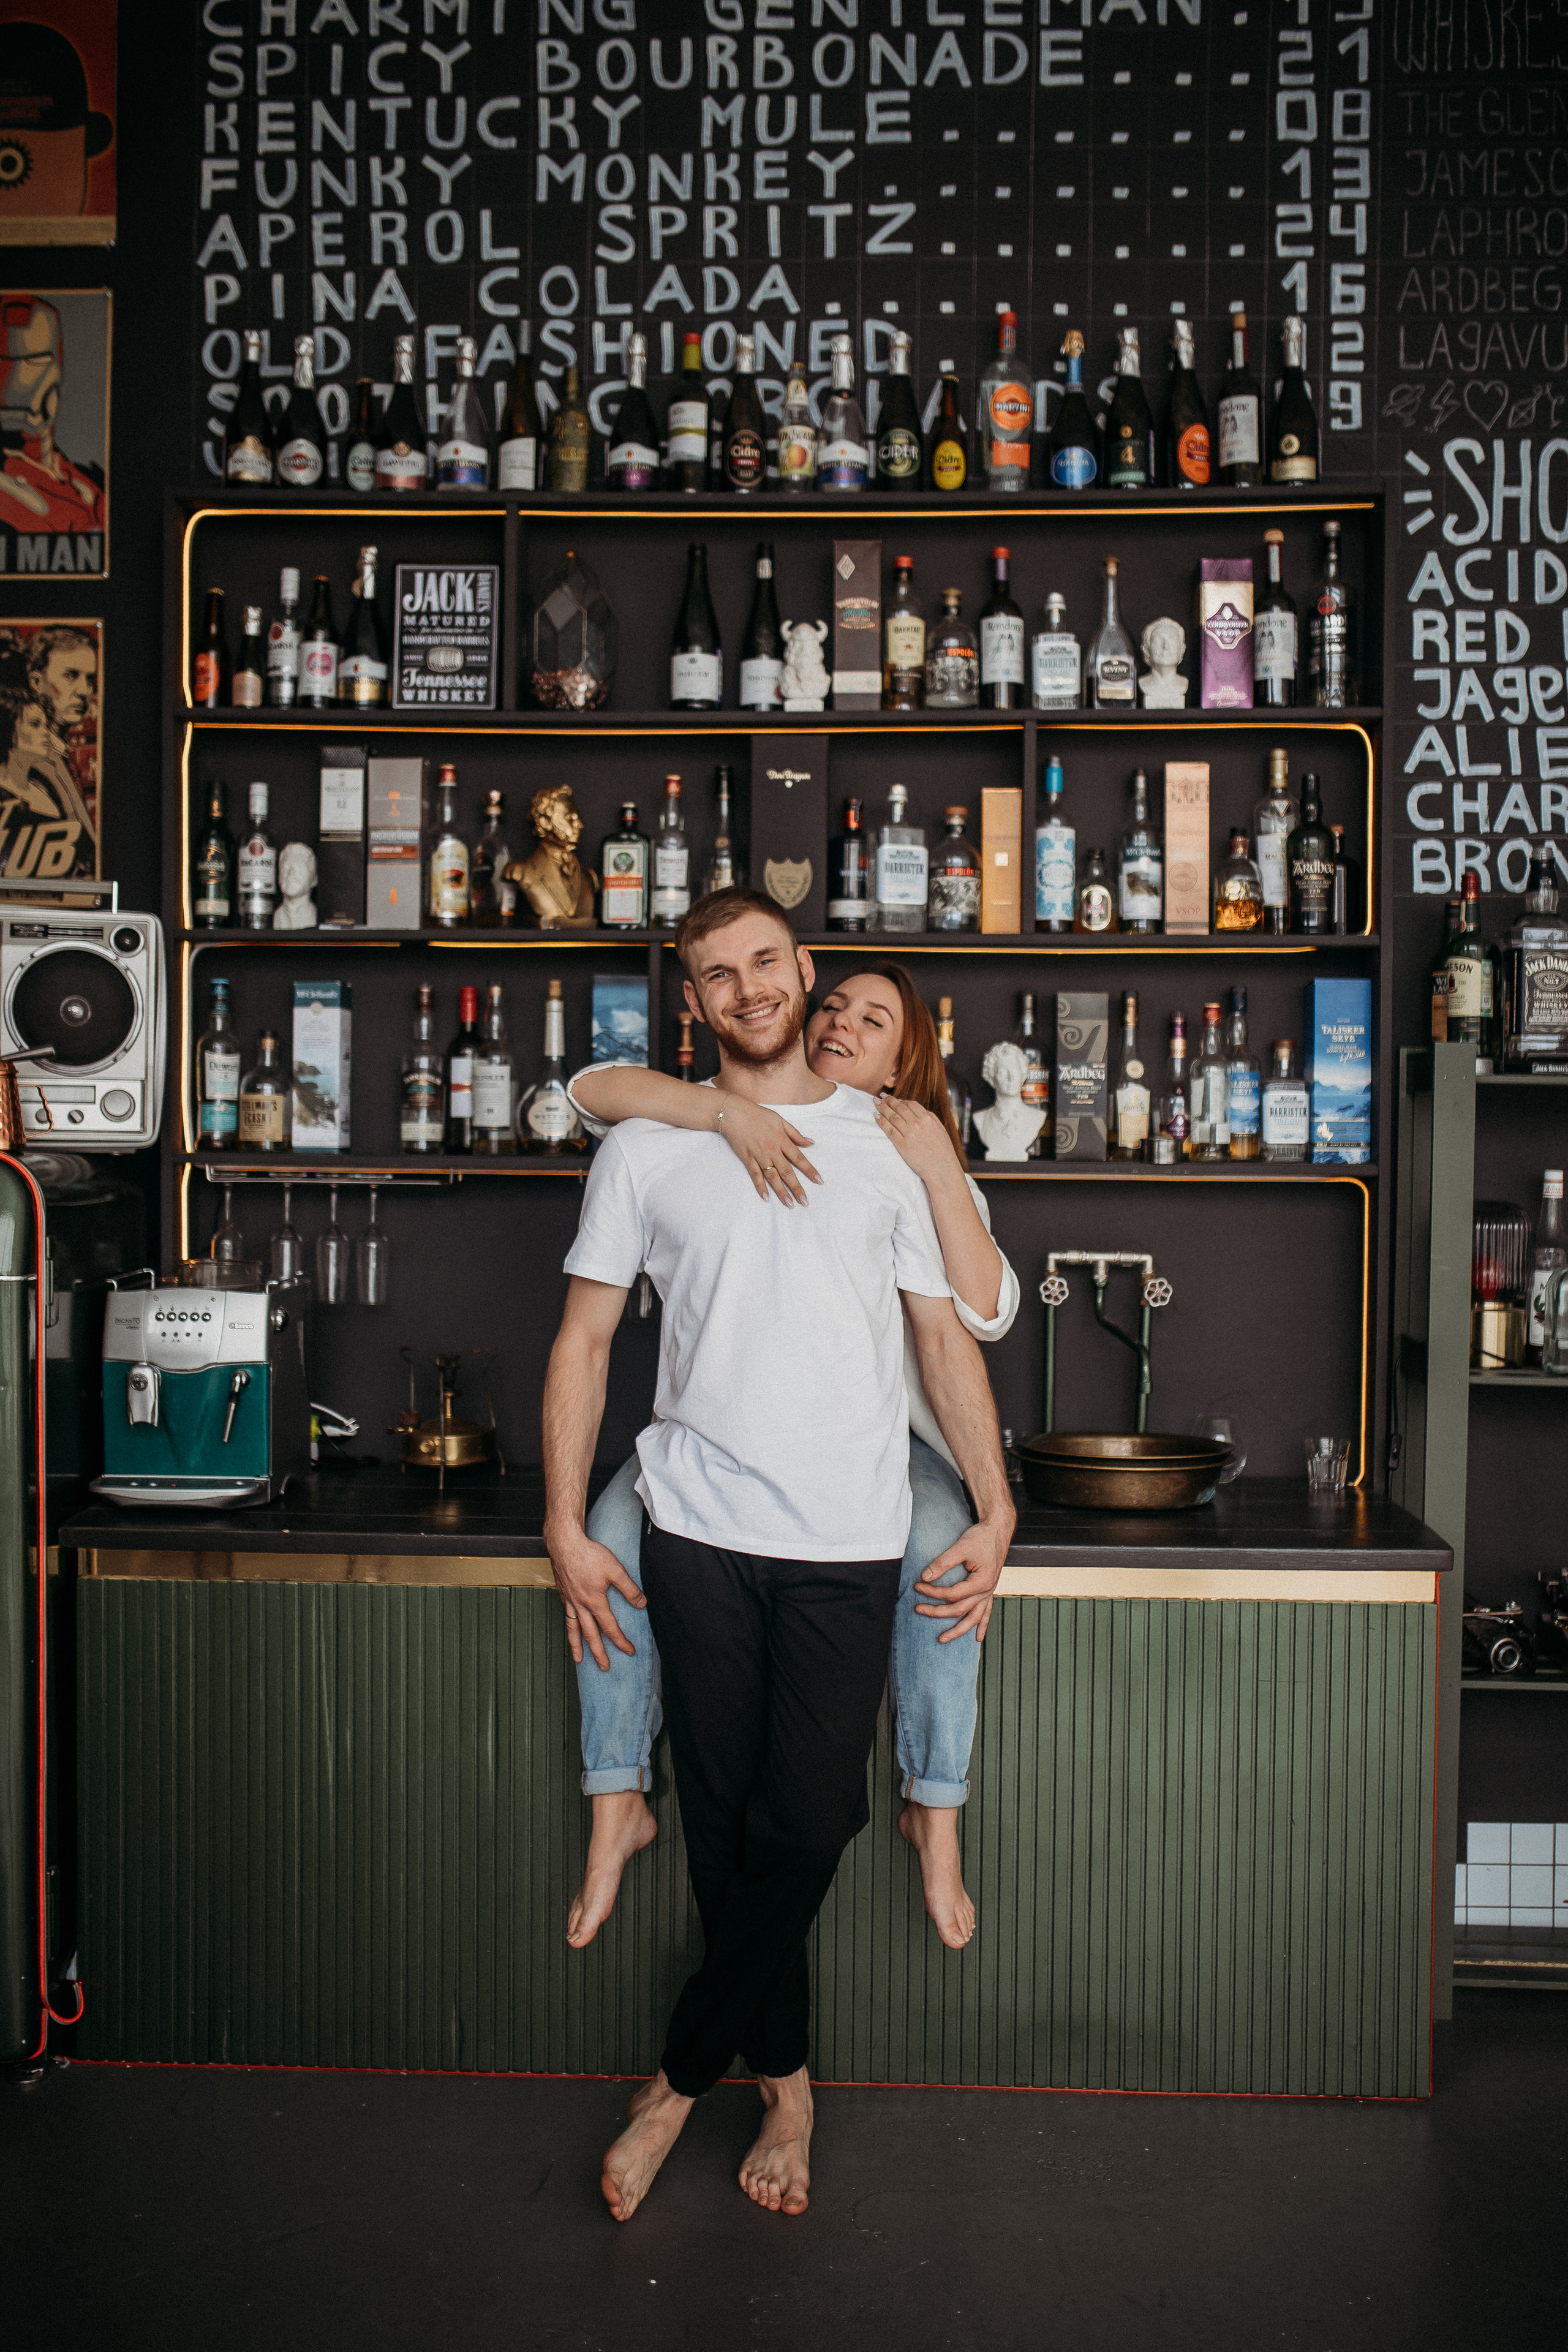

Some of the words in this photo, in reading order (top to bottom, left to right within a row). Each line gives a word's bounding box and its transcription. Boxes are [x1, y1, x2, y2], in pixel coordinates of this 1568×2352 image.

[208, 42, 470, 96] SPICY
[537, 29, 1084, 92] BOURBONADE
[205, 96, 641, 153] KENTUCKY
[701, 91, 911, 148] MULE
[201, 155, 472, 209] FUNKY
[537, 149, 854, 202] MONKEY
[197, 209, 520, 268] APEROL
[595, 203, 916, 263] SPRITZ
[205, 269, 417, 323] PINA
[478, 264, 801, 316] COLADA
[1398, 267, 1561, 312] ARDBEG
[202, 326, 350, 380] OLD
[425, 320, 900, 376] FASHIONED
[994, 401, 1030, 413] MARTINI
[879, 444, 918, 459] CIDER
[17, 534, 100, 573] MAN
[402, 572, 476, 612] JACK
[1408, 547, 1568, 606] ACID
[402, 615, 491, 627] MATURED
[1412, 608, 1531, 664] RED
[402, 668, 488, 688] Tennessee
[402, 689, 487, 703] WHISKEY
[1321, 1024, 1365, 1035] TALISKER
[1058, 1066, 1106, 1082] Ardbeg
